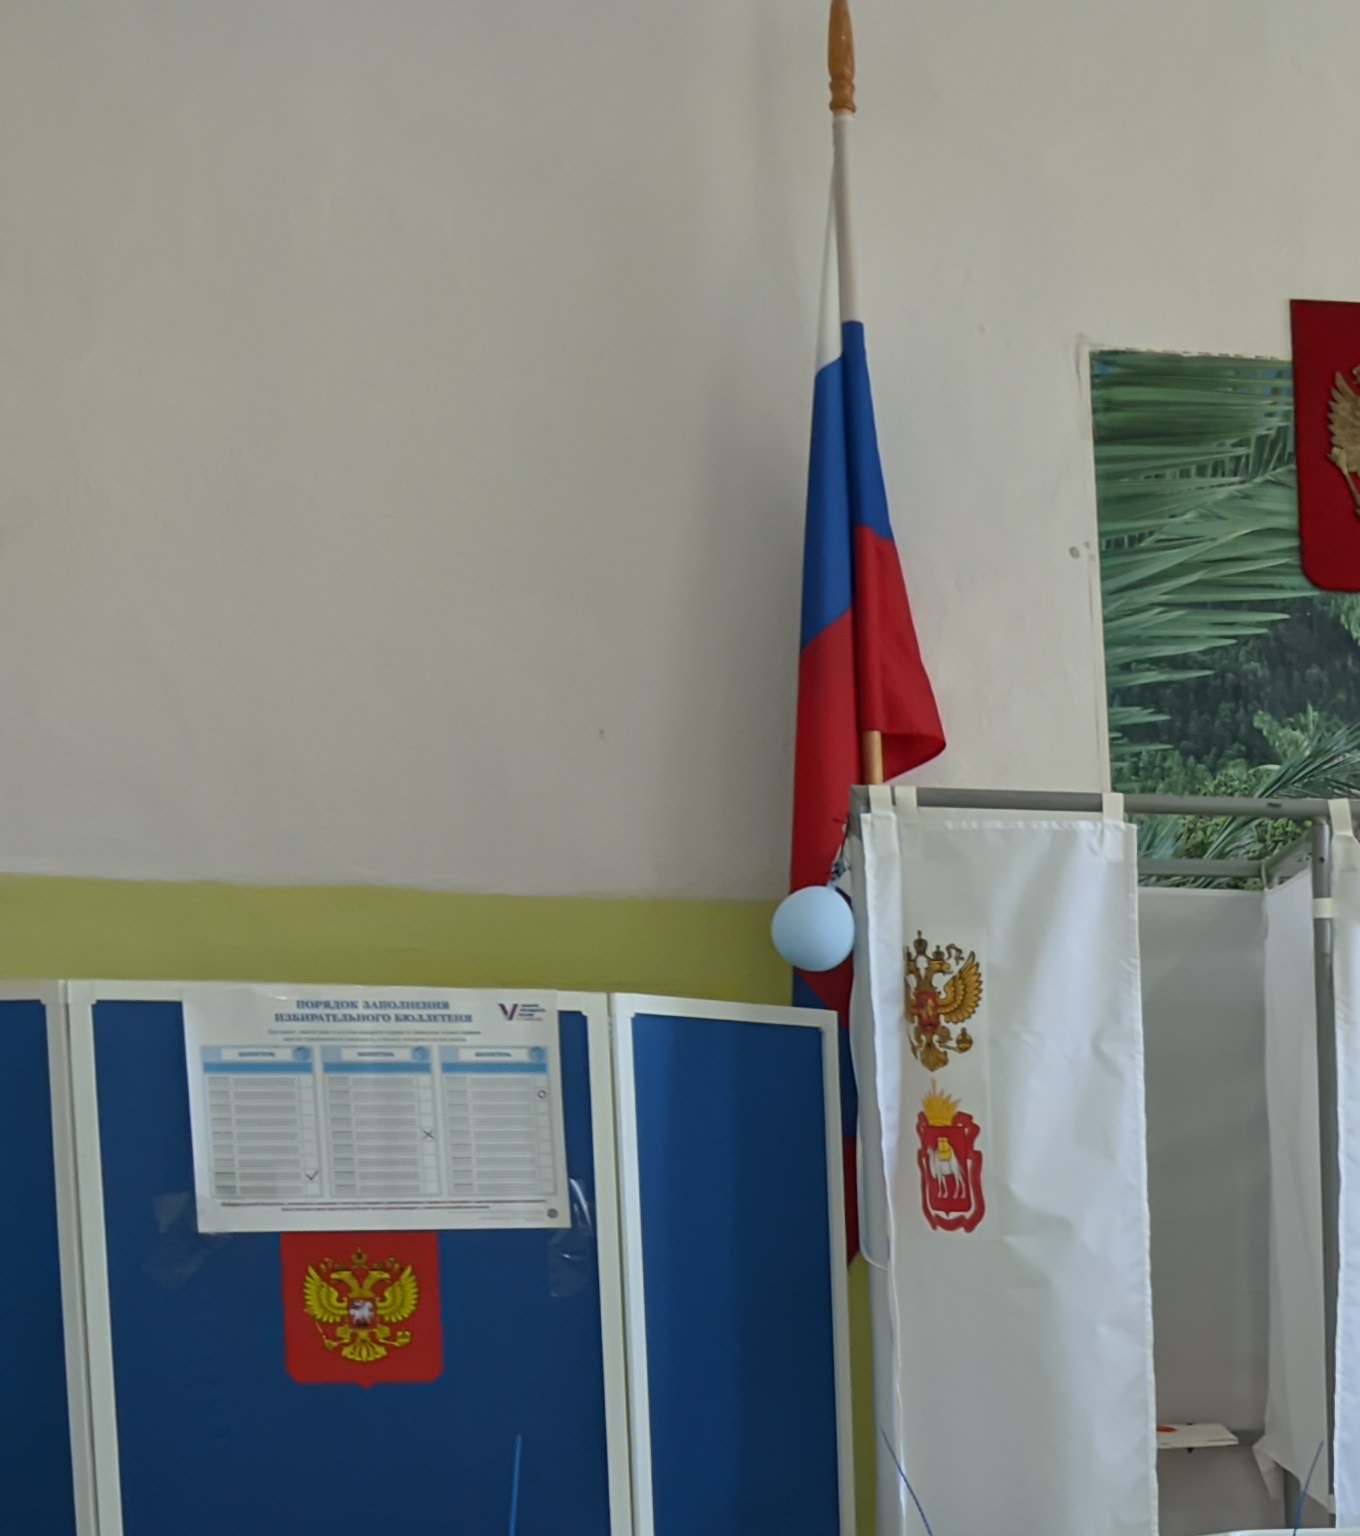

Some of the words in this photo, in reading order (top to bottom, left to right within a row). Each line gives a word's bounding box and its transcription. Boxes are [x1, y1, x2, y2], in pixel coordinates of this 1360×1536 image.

[296, 1000, 358, 1010] ПОРЯДОК
[362, 1000, 450, 1010] ЗАПОЛНЕНИЯ
[274, 1013, 392, 1023] ИЗБИРАТЕЛЬНОГО
[394, 1013, 473, 1023] БЮЛЛЕТЕНЯ
